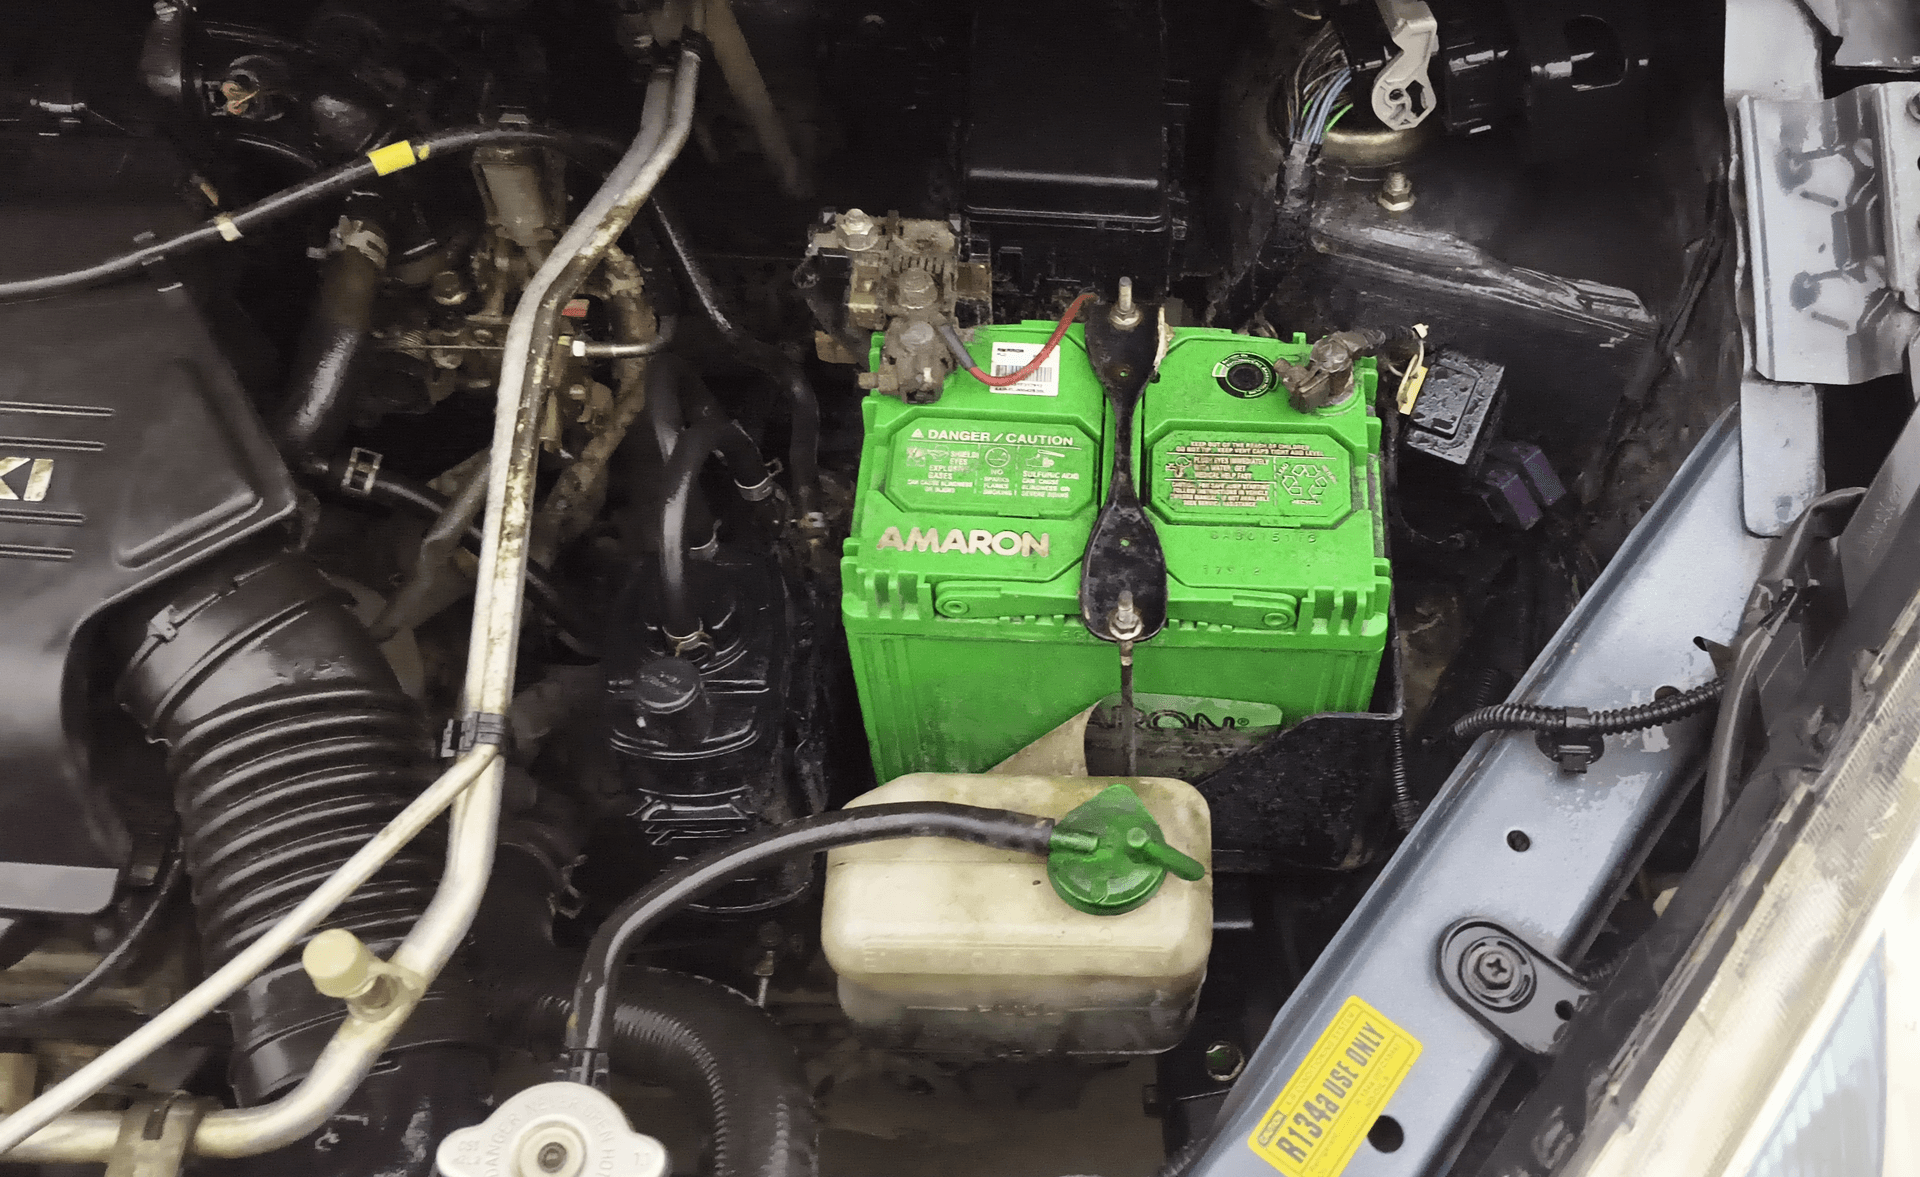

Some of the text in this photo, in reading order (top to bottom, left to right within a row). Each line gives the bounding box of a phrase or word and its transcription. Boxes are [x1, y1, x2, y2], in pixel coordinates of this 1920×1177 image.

[928, 429, 990, 442] DANGER
[1005, 433, 1073, 446] CAUTION
[876, 526, 1049, 558] AMARON
[1275, 1021, 1385, 1164] R134a USE ONLY
